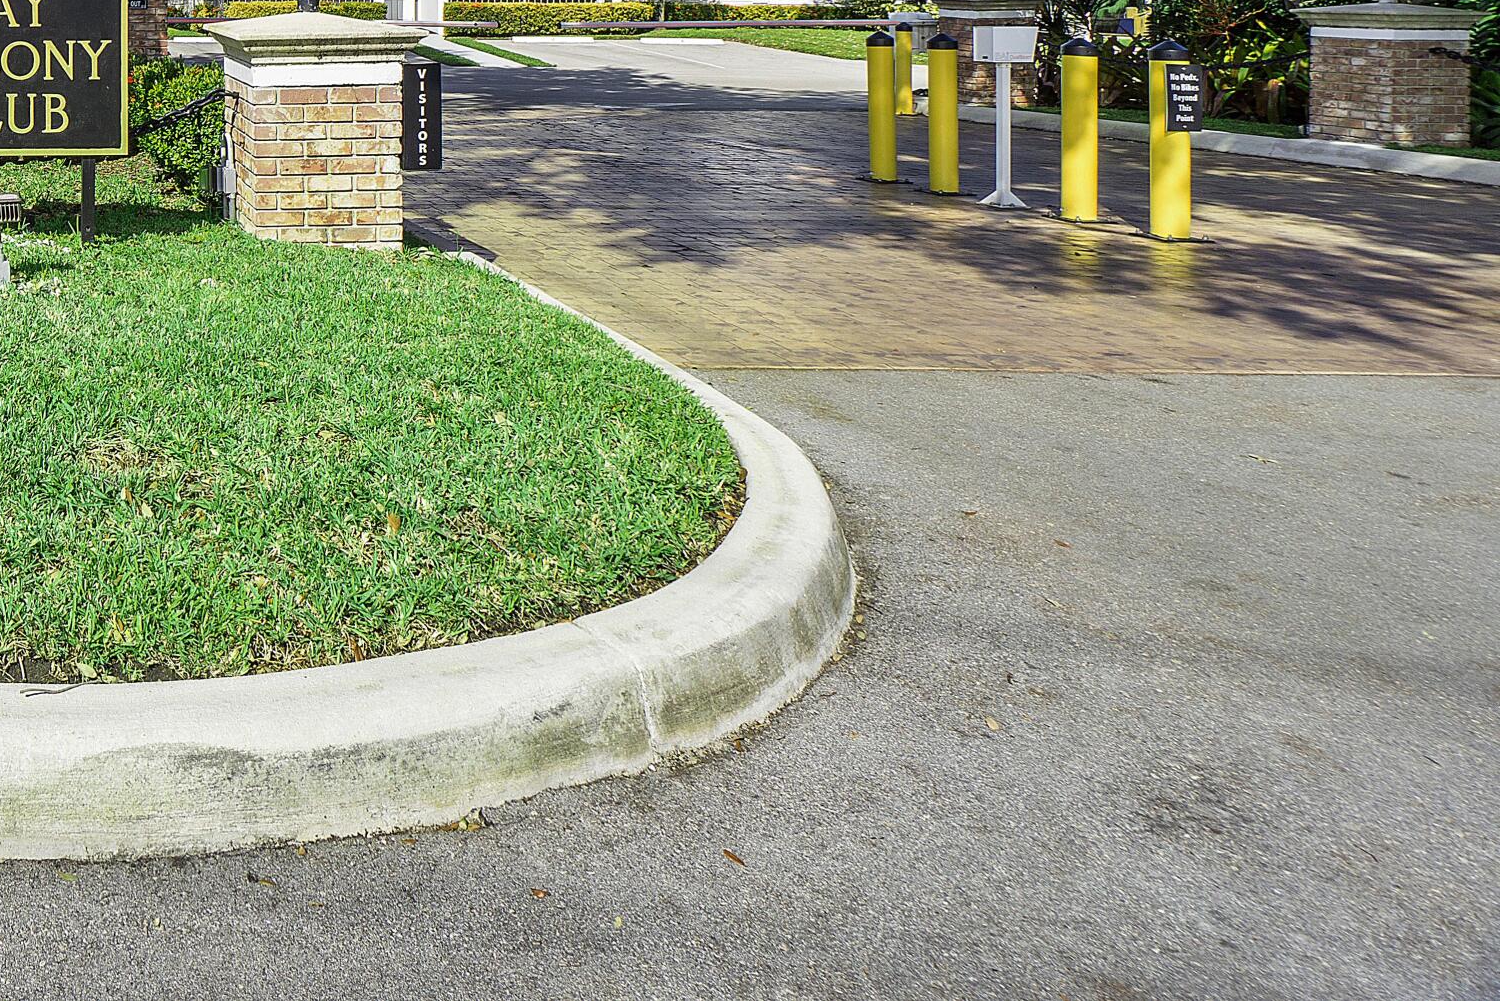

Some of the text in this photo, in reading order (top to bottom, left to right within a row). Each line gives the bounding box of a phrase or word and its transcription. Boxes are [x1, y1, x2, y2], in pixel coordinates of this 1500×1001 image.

[1170, 73, 1179, 81] No
[1171, 83, 1199, 91] No Bikes
[1173, 94, 1198, 103] Beyond
[417, 68, 428, 166] VISITORS
[1176, 114, 1194, 122] Point
